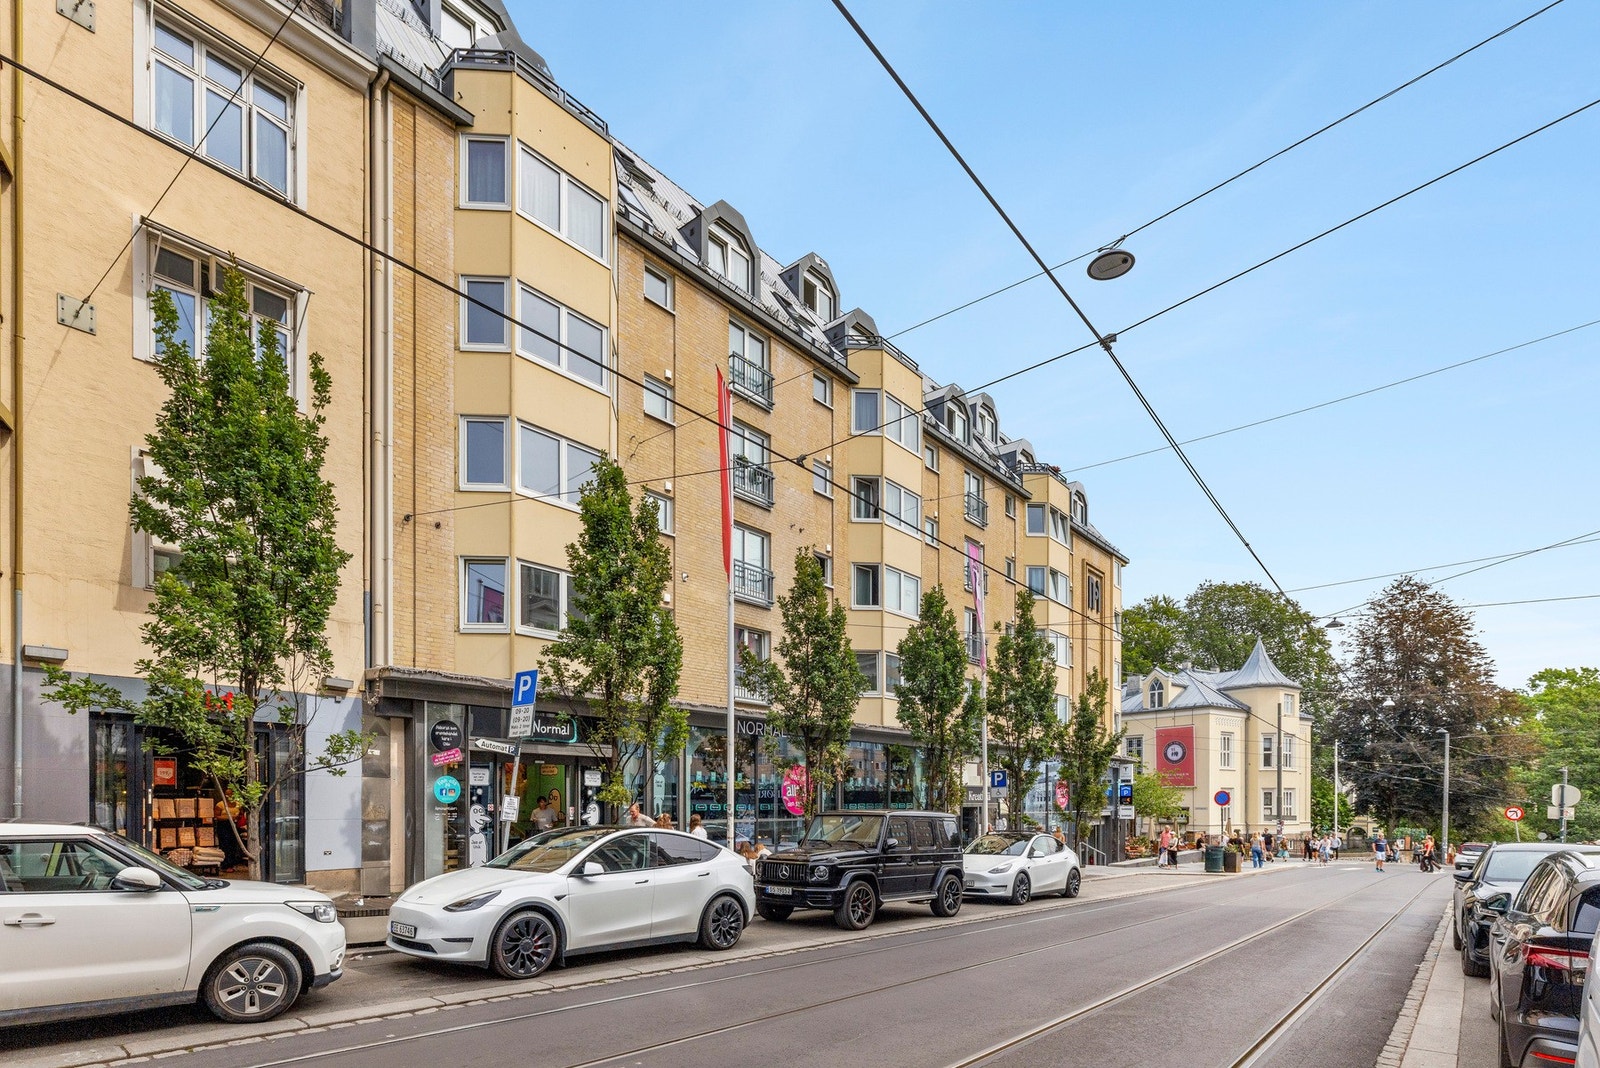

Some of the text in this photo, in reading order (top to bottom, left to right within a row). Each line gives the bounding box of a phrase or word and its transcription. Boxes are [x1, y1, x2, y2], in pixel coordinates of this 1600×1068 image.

[518, 675, 532, 702] P
[533, 719, 570, 735] Normal
[481, 740, 508, 752] Automat
[994, 772, 1004, 786] P
